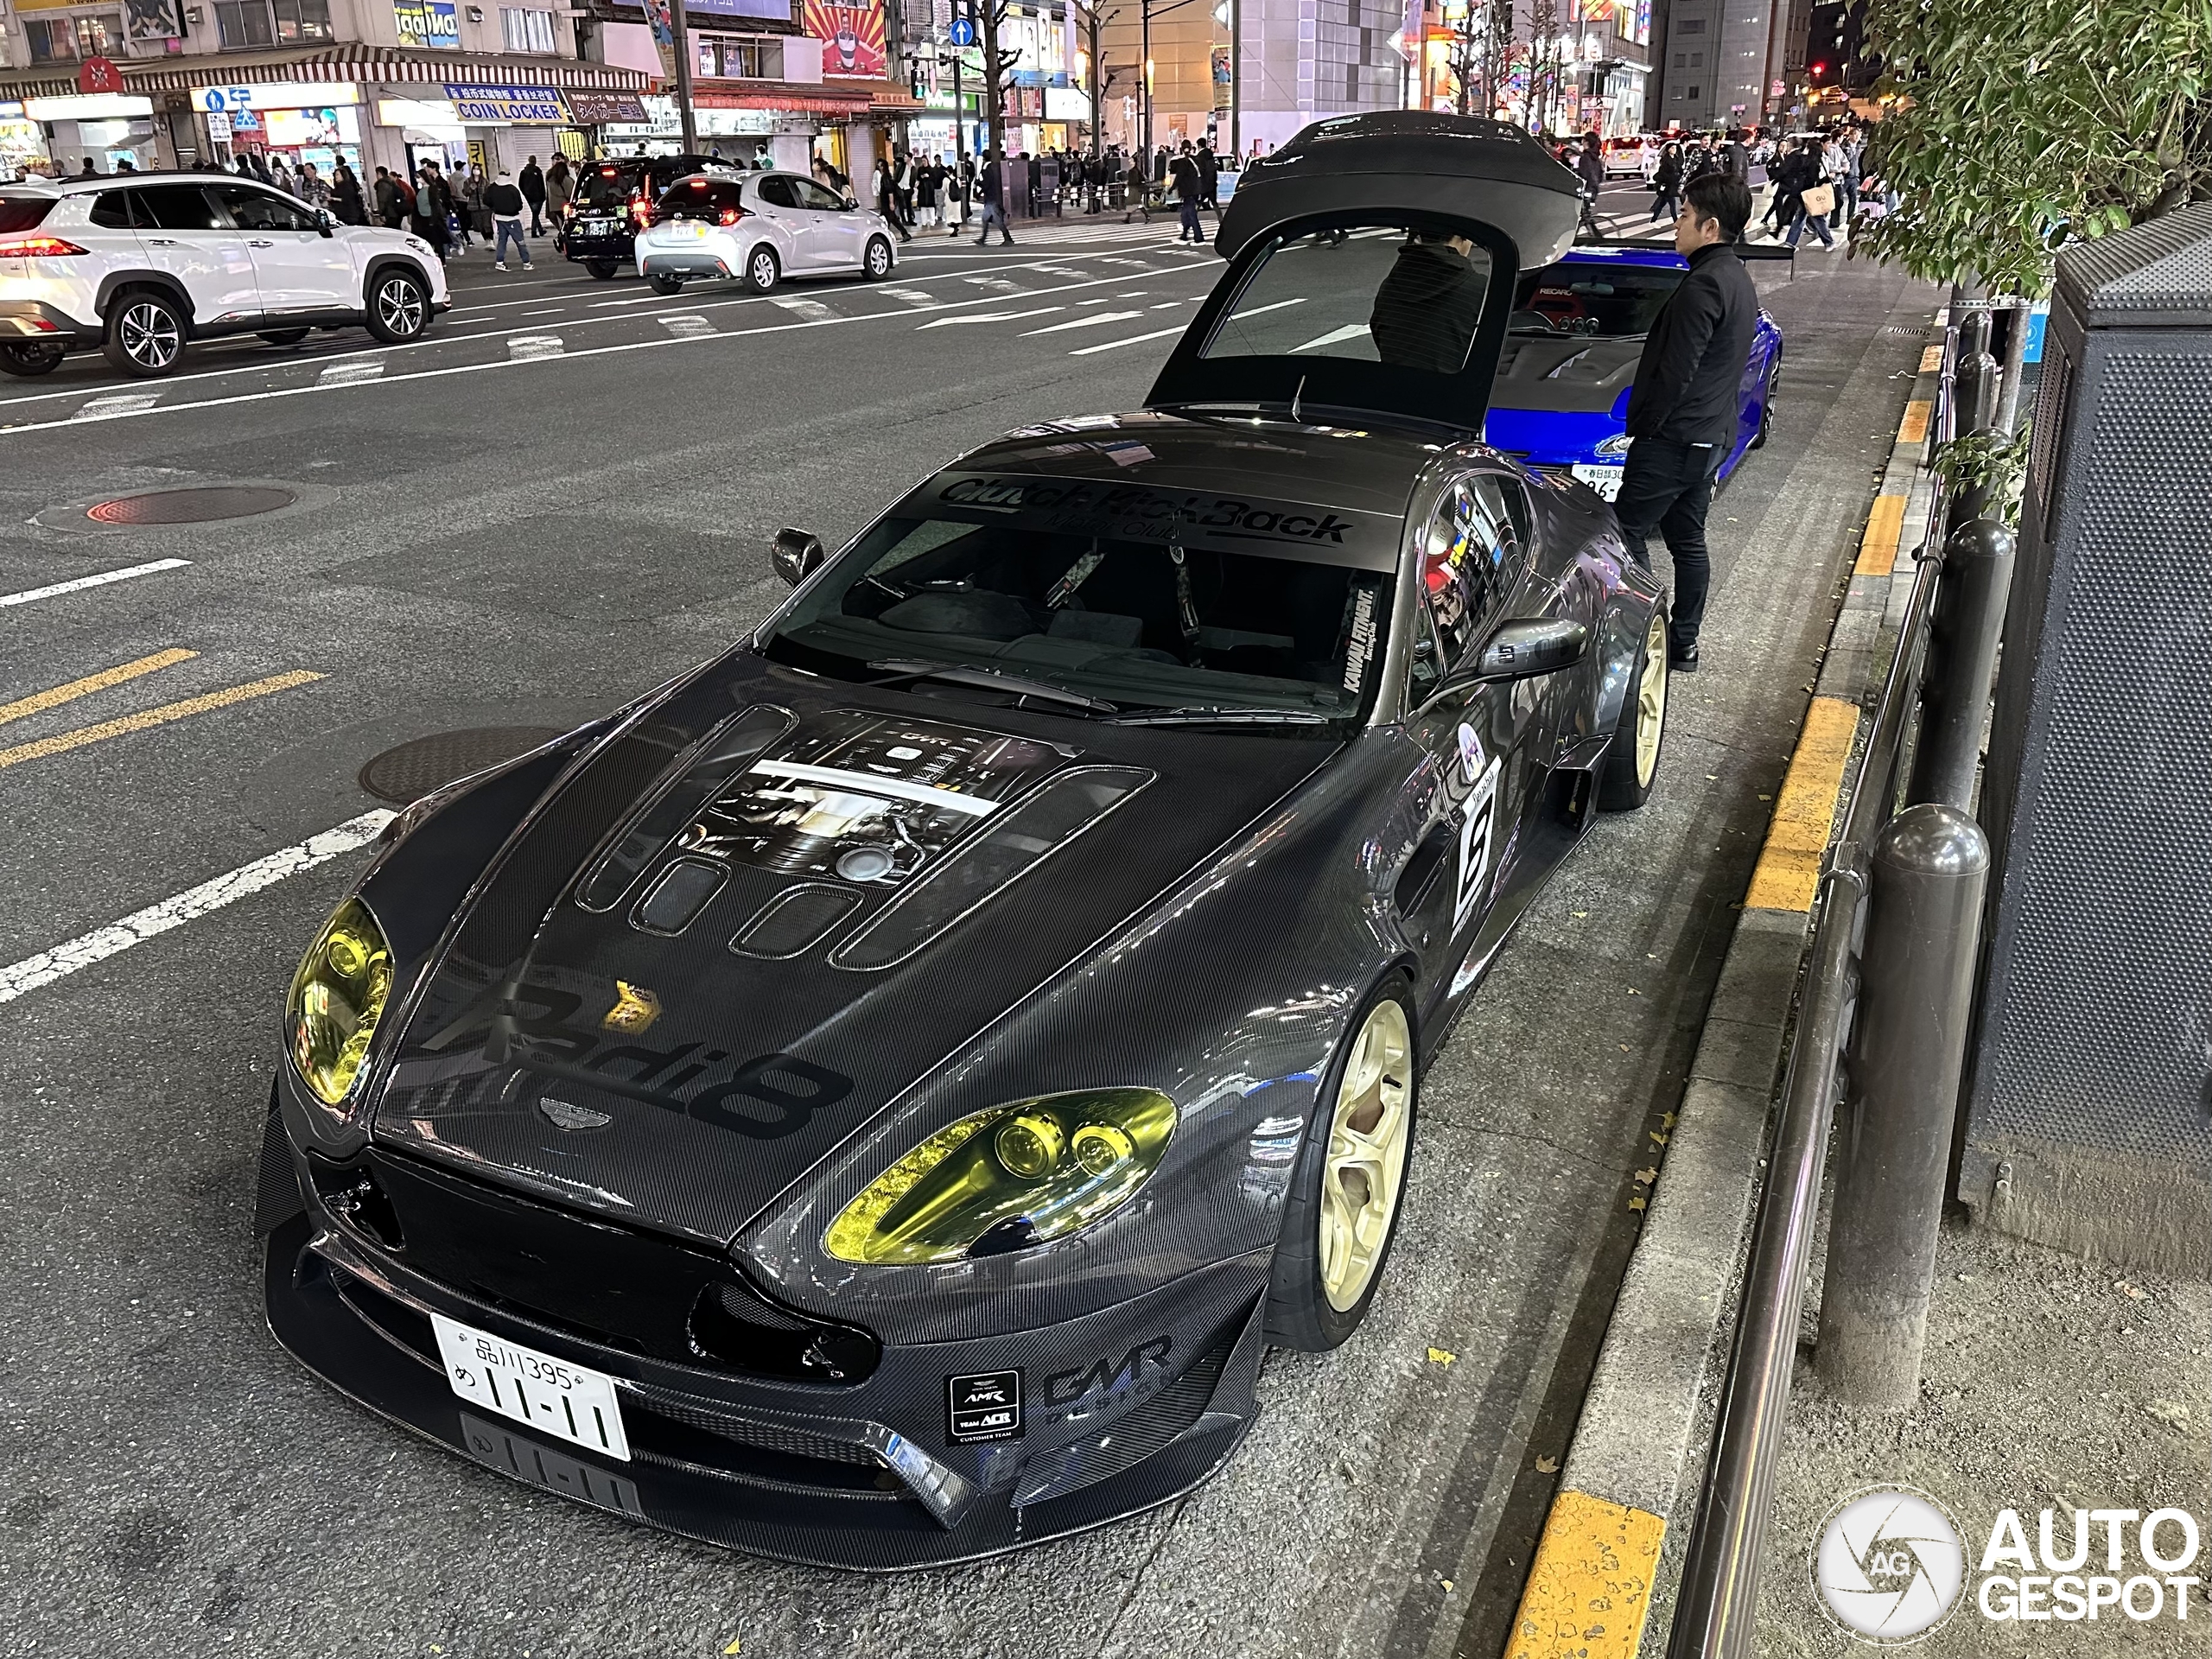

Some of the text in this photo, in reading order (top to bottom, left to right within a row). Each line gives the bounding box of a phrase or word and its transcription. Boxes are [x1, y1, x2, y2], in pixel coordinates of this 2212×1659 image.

[458, 102, 563, 119] COIN LOCKER
[1343, 640, 1365, 694] KAWAII
[475, 1338, 572, 1389] 品川395
[454, 1363, 609, 1449] め 11-11
[964, 1390, 1006, 1403] AMR
[960, 1434, 995, 1443] CUSTOMER
